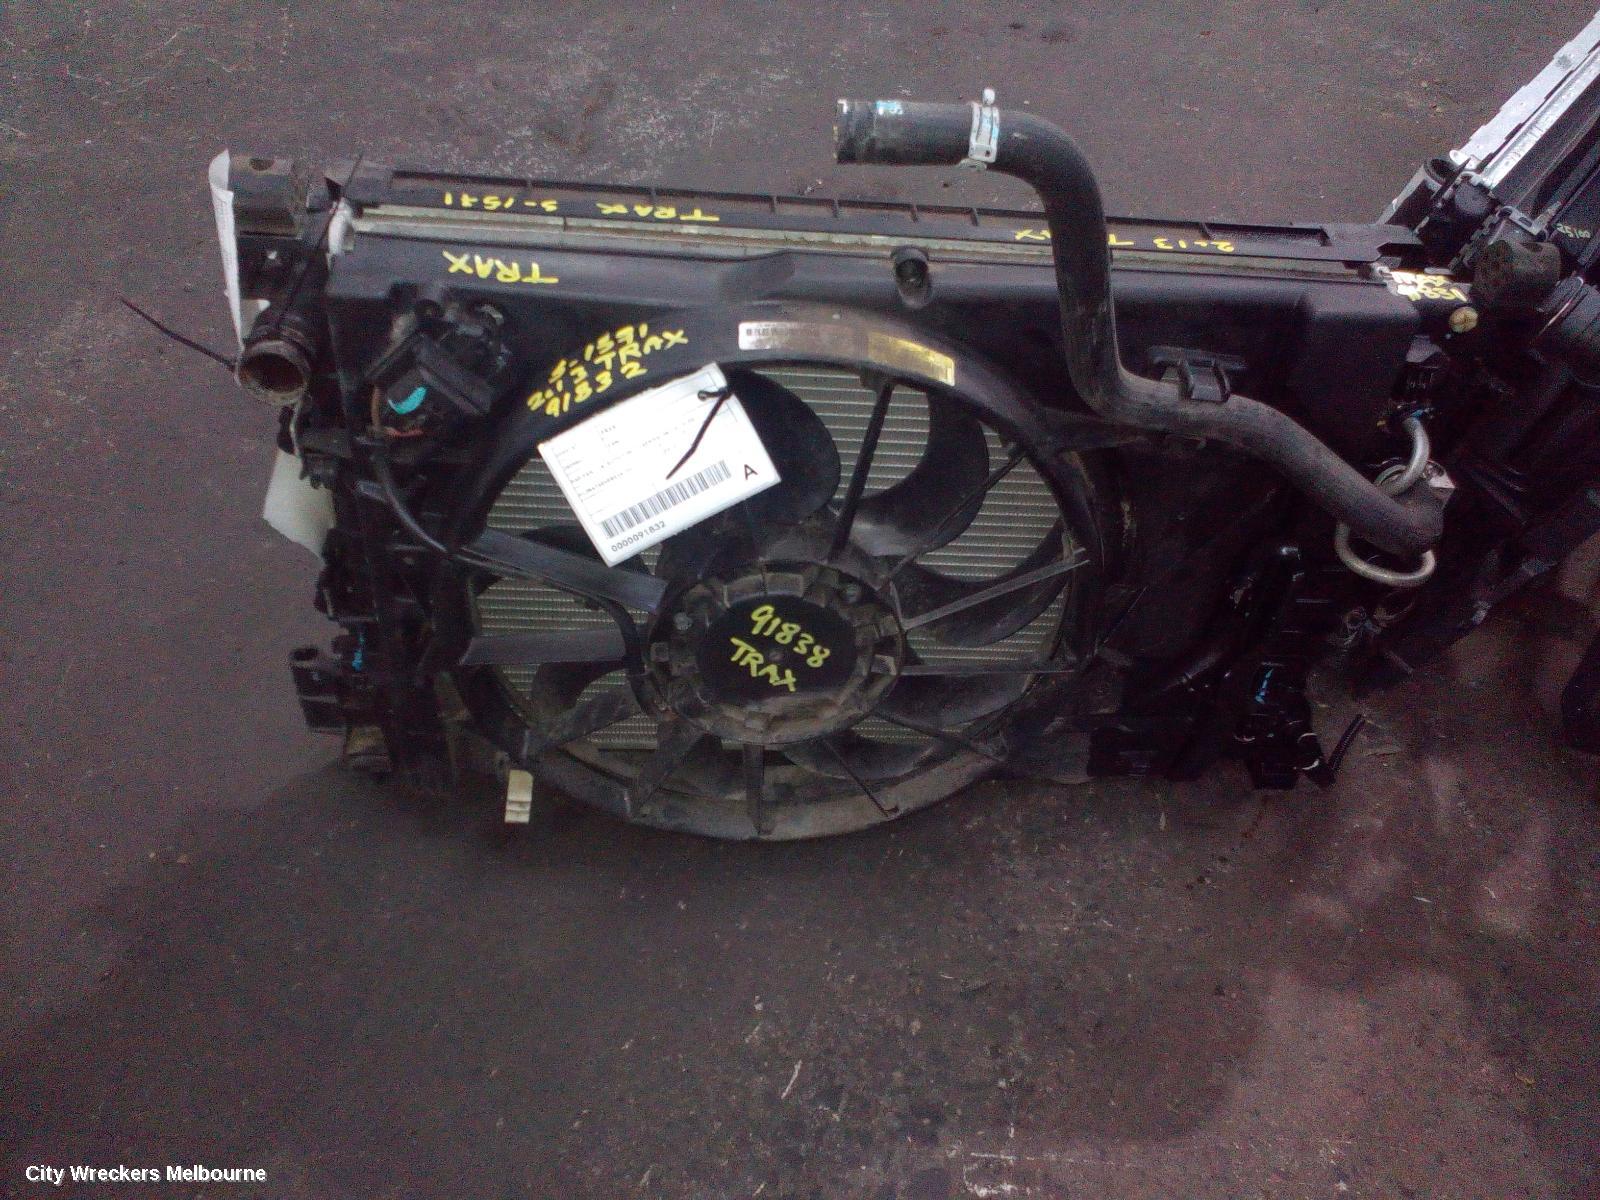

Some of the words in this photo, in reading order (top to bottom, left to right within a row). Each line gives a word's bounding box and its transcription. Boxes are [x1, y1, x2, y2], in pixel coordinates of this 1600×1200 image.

[595, 202, 720, 222] TRAX
[442, 250, 559, 284] TRAX
[594, 328, 689, 371] TRAX
[545, 360, 648, 418] 91832
[742, 463, 759, 481] A
[610, 520, 667, 553] 0000091832
[750, 604, 831, 668] 91838
[730, 636, 797, 692] TRAX
